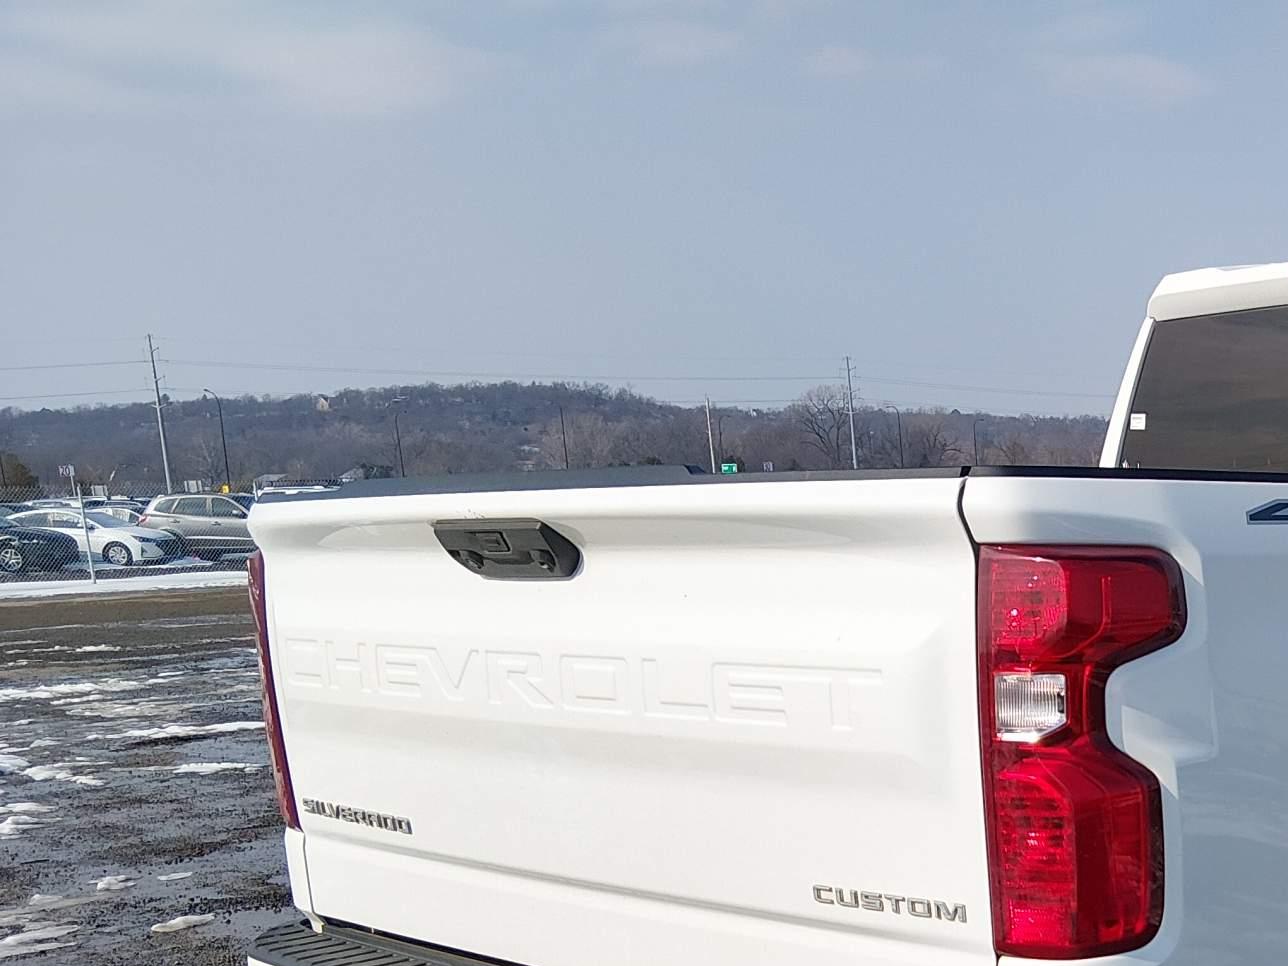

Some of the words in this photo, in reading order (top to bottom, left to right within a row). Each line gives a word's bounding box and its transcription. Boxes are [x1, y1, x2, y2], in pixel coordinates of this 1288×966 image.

[284, 638, 883, 731] CHEVROLET
[302, 797, 413, 835] SILVERADO
[812, 883, 968, 924] CUSTOM
